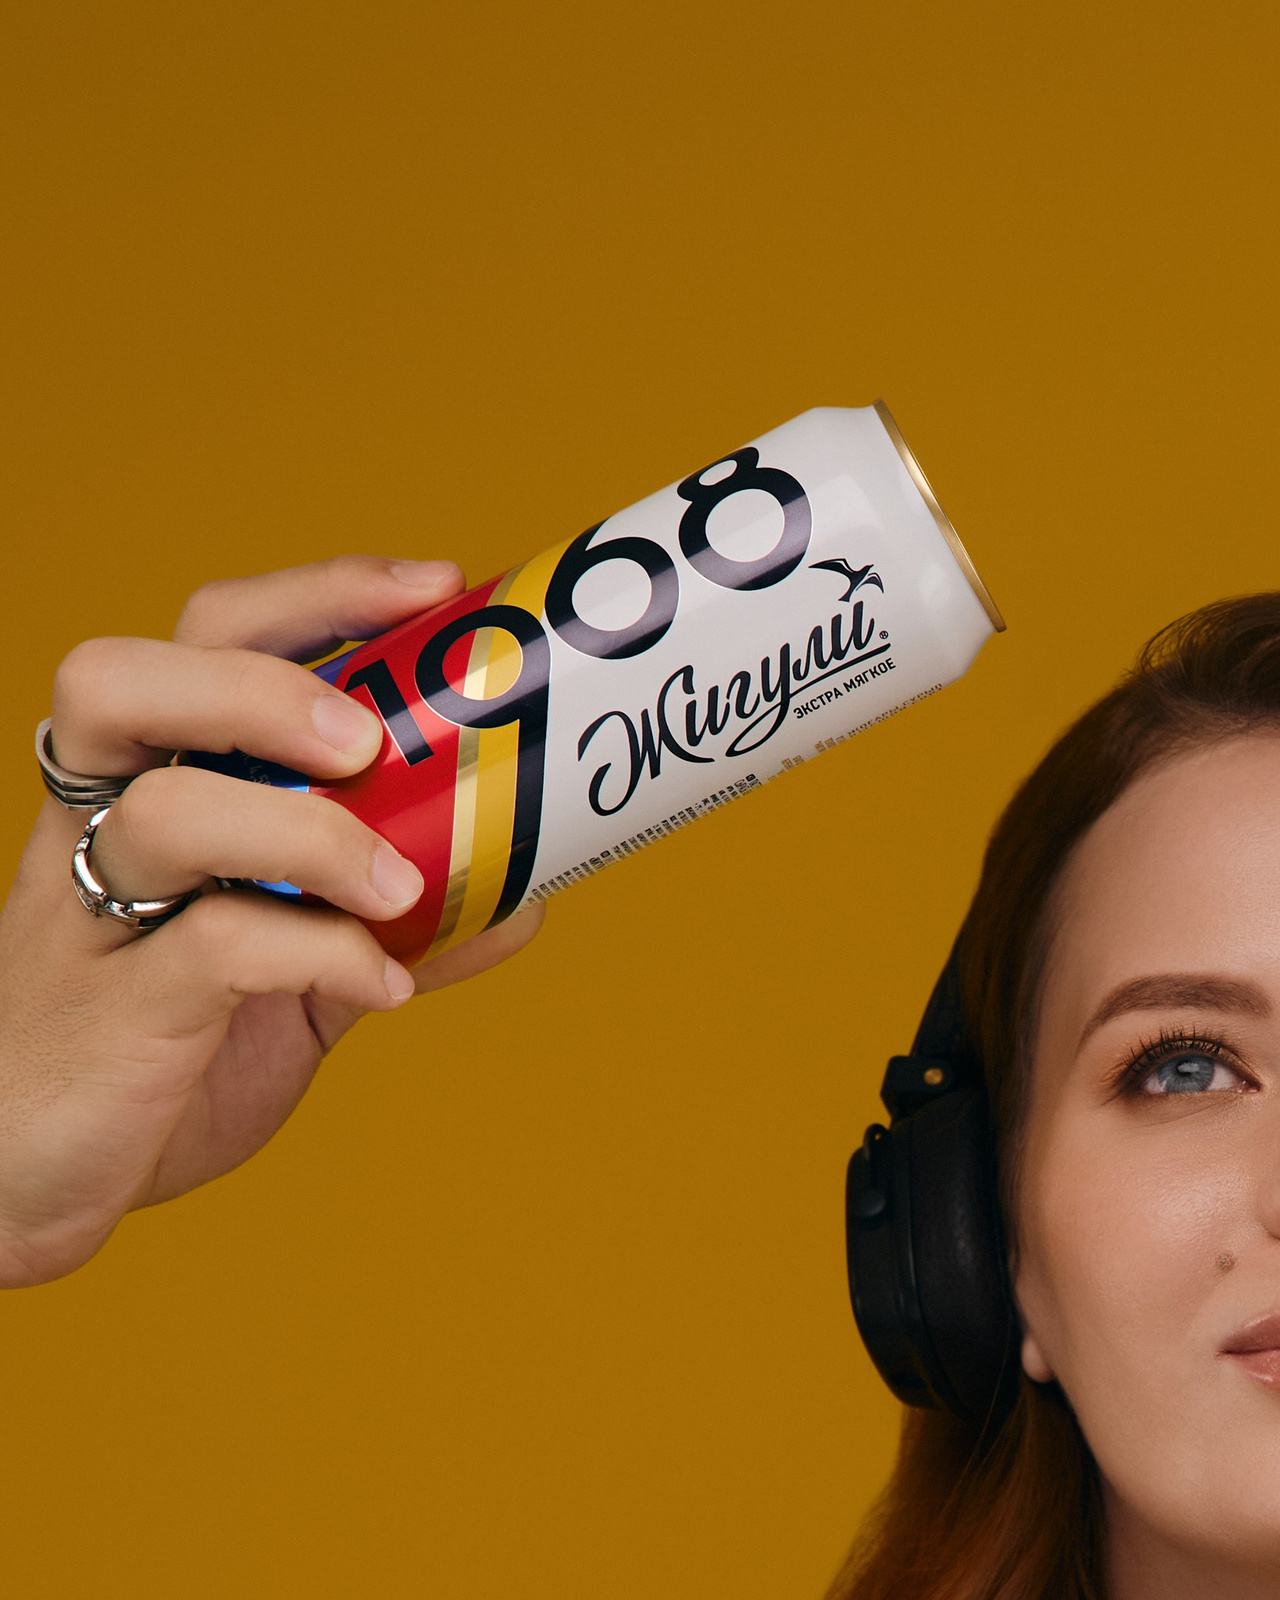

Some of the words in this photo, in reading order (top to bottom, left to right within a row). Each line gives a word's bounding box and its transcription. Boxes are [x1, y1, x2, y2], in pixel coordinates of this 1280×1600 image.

[344, 446, 814, 933] 1968
[577, 602, 891, 818] Жигули
[792, 688, 844, 720] ЭКСТРА
[842, 657, 897, 693] МЯГКОЕ
